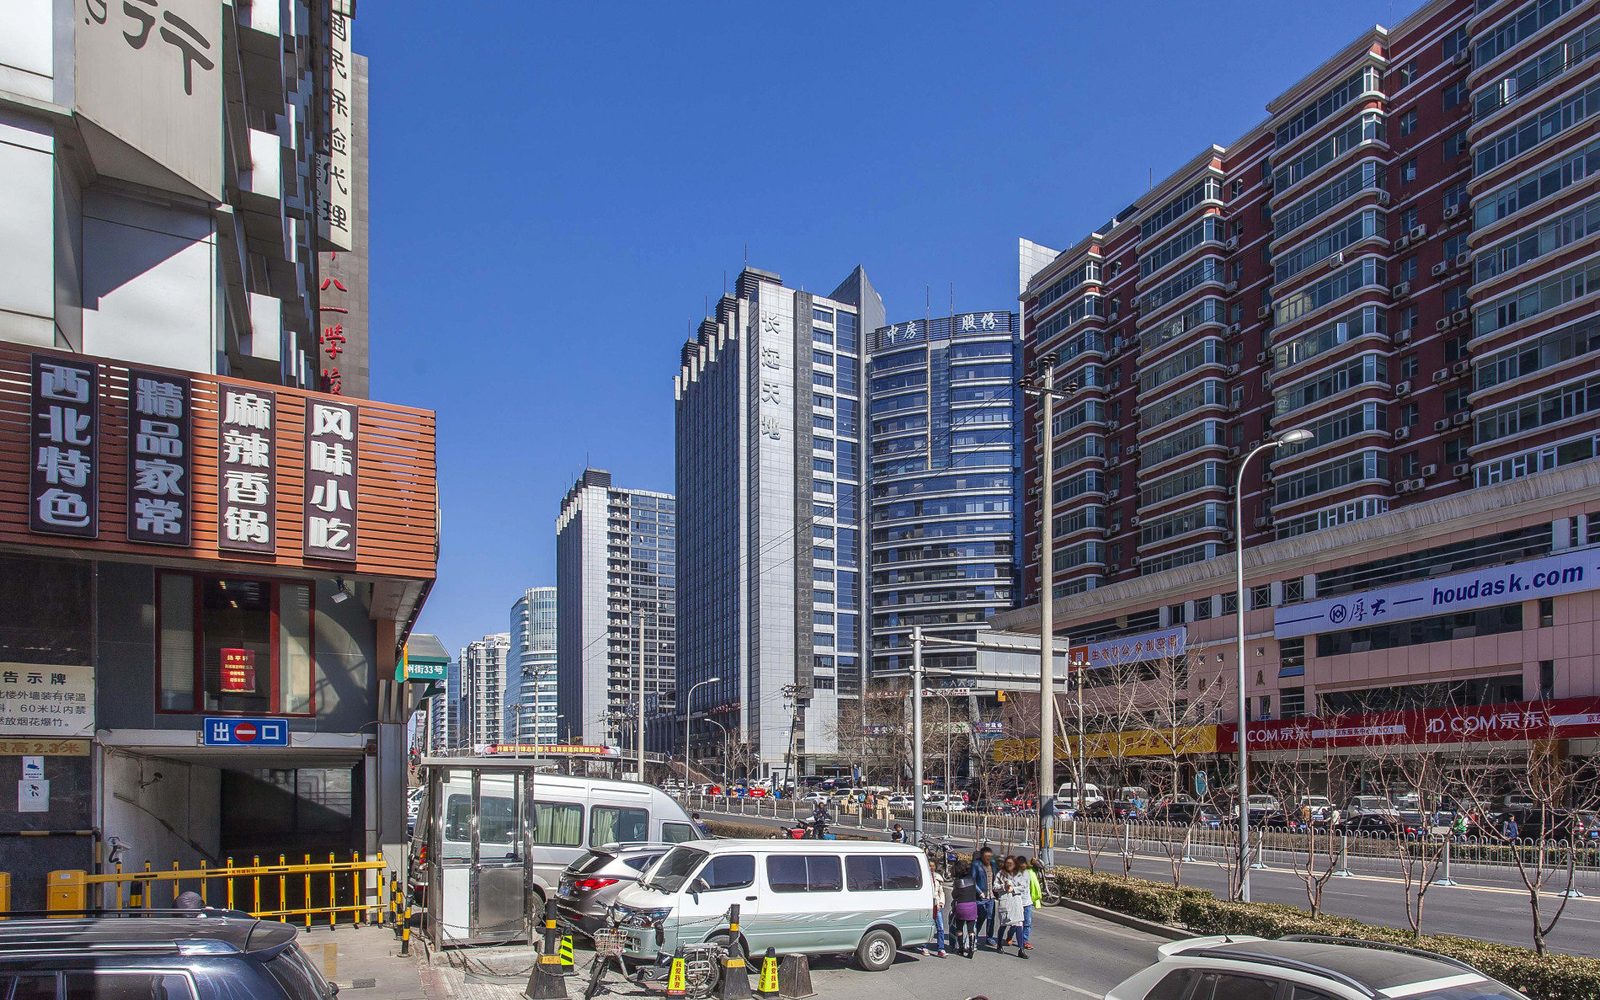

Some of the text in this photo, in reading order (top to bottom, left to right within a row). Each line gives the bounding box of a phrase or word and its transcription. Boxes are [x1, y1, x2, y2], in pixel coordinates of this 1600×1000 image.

[319, 249, 348, 396] 八一学校
[761, 310, 781, 440] 长远天地
[886, 312, 999, 344] 中房 股份
[37, 362, 92, 529] 西北特色
[133, 378, 185, 536] 精品家常
[223, 391, 271, 545] 麻辣香锅
[309, 403, 354, 553] 风味小吃
[1431, 564, 1584, 605] houdask.com
[3, 671, 67, 686] 告示牌
